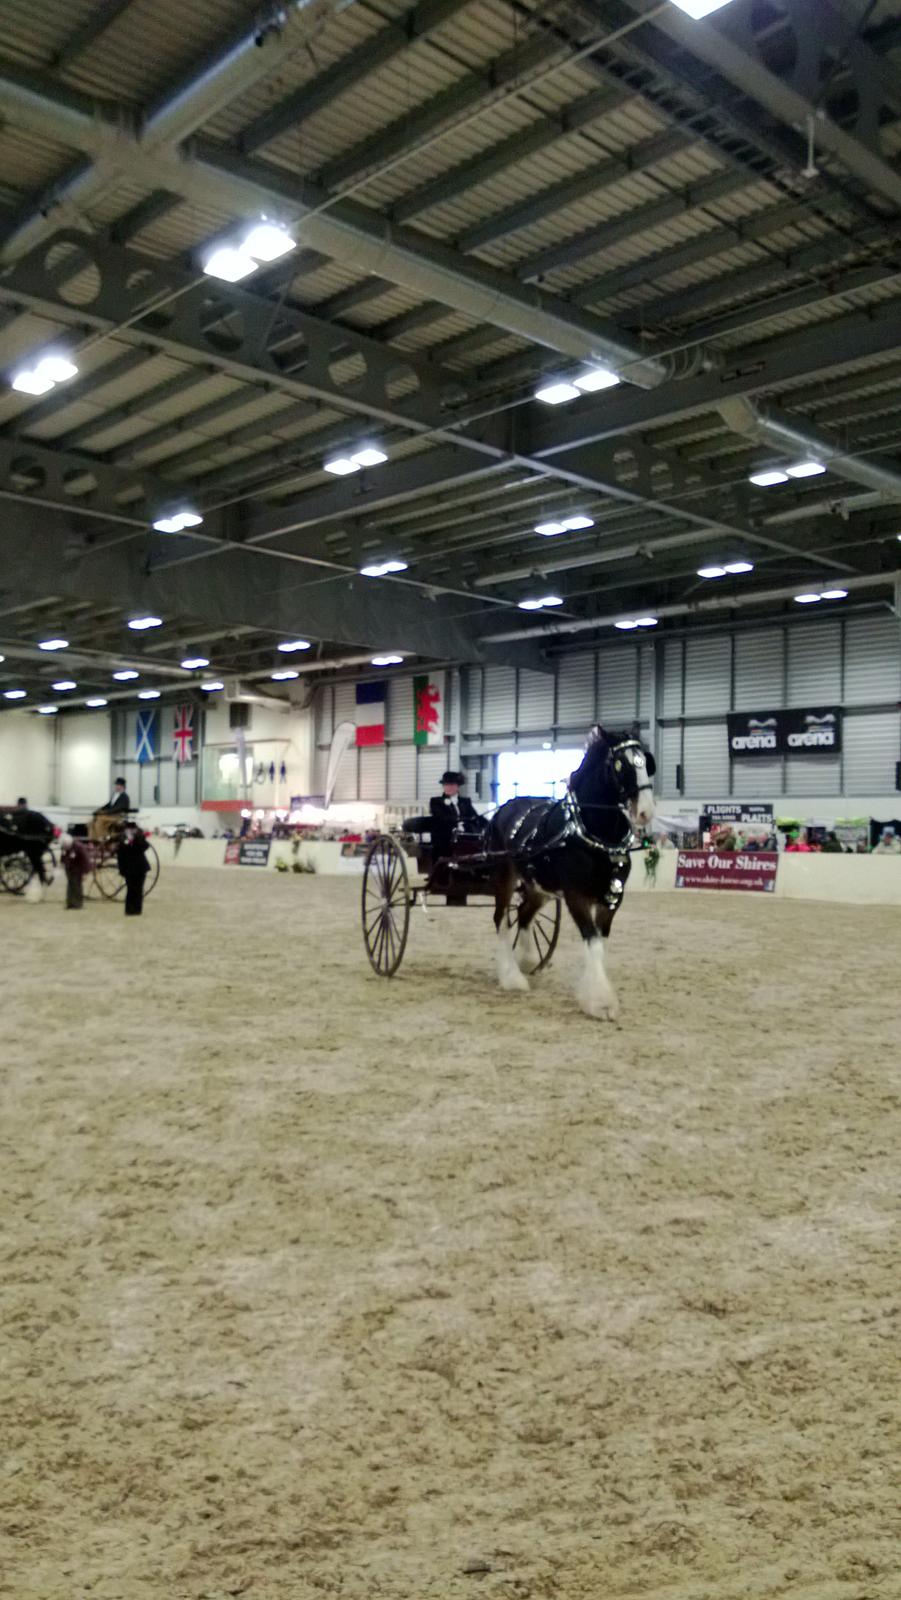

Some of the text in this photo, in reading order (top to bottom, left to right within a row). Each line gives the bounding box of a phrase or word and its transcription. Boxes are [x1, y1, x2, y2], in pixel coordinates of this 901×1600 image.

[732, 735, 776, 749] arena
[788, 733, 834, 747] arena
[707, 805, 741, 814] FLIGHTS
[678, 854, 776, 870] Save Our Shires
